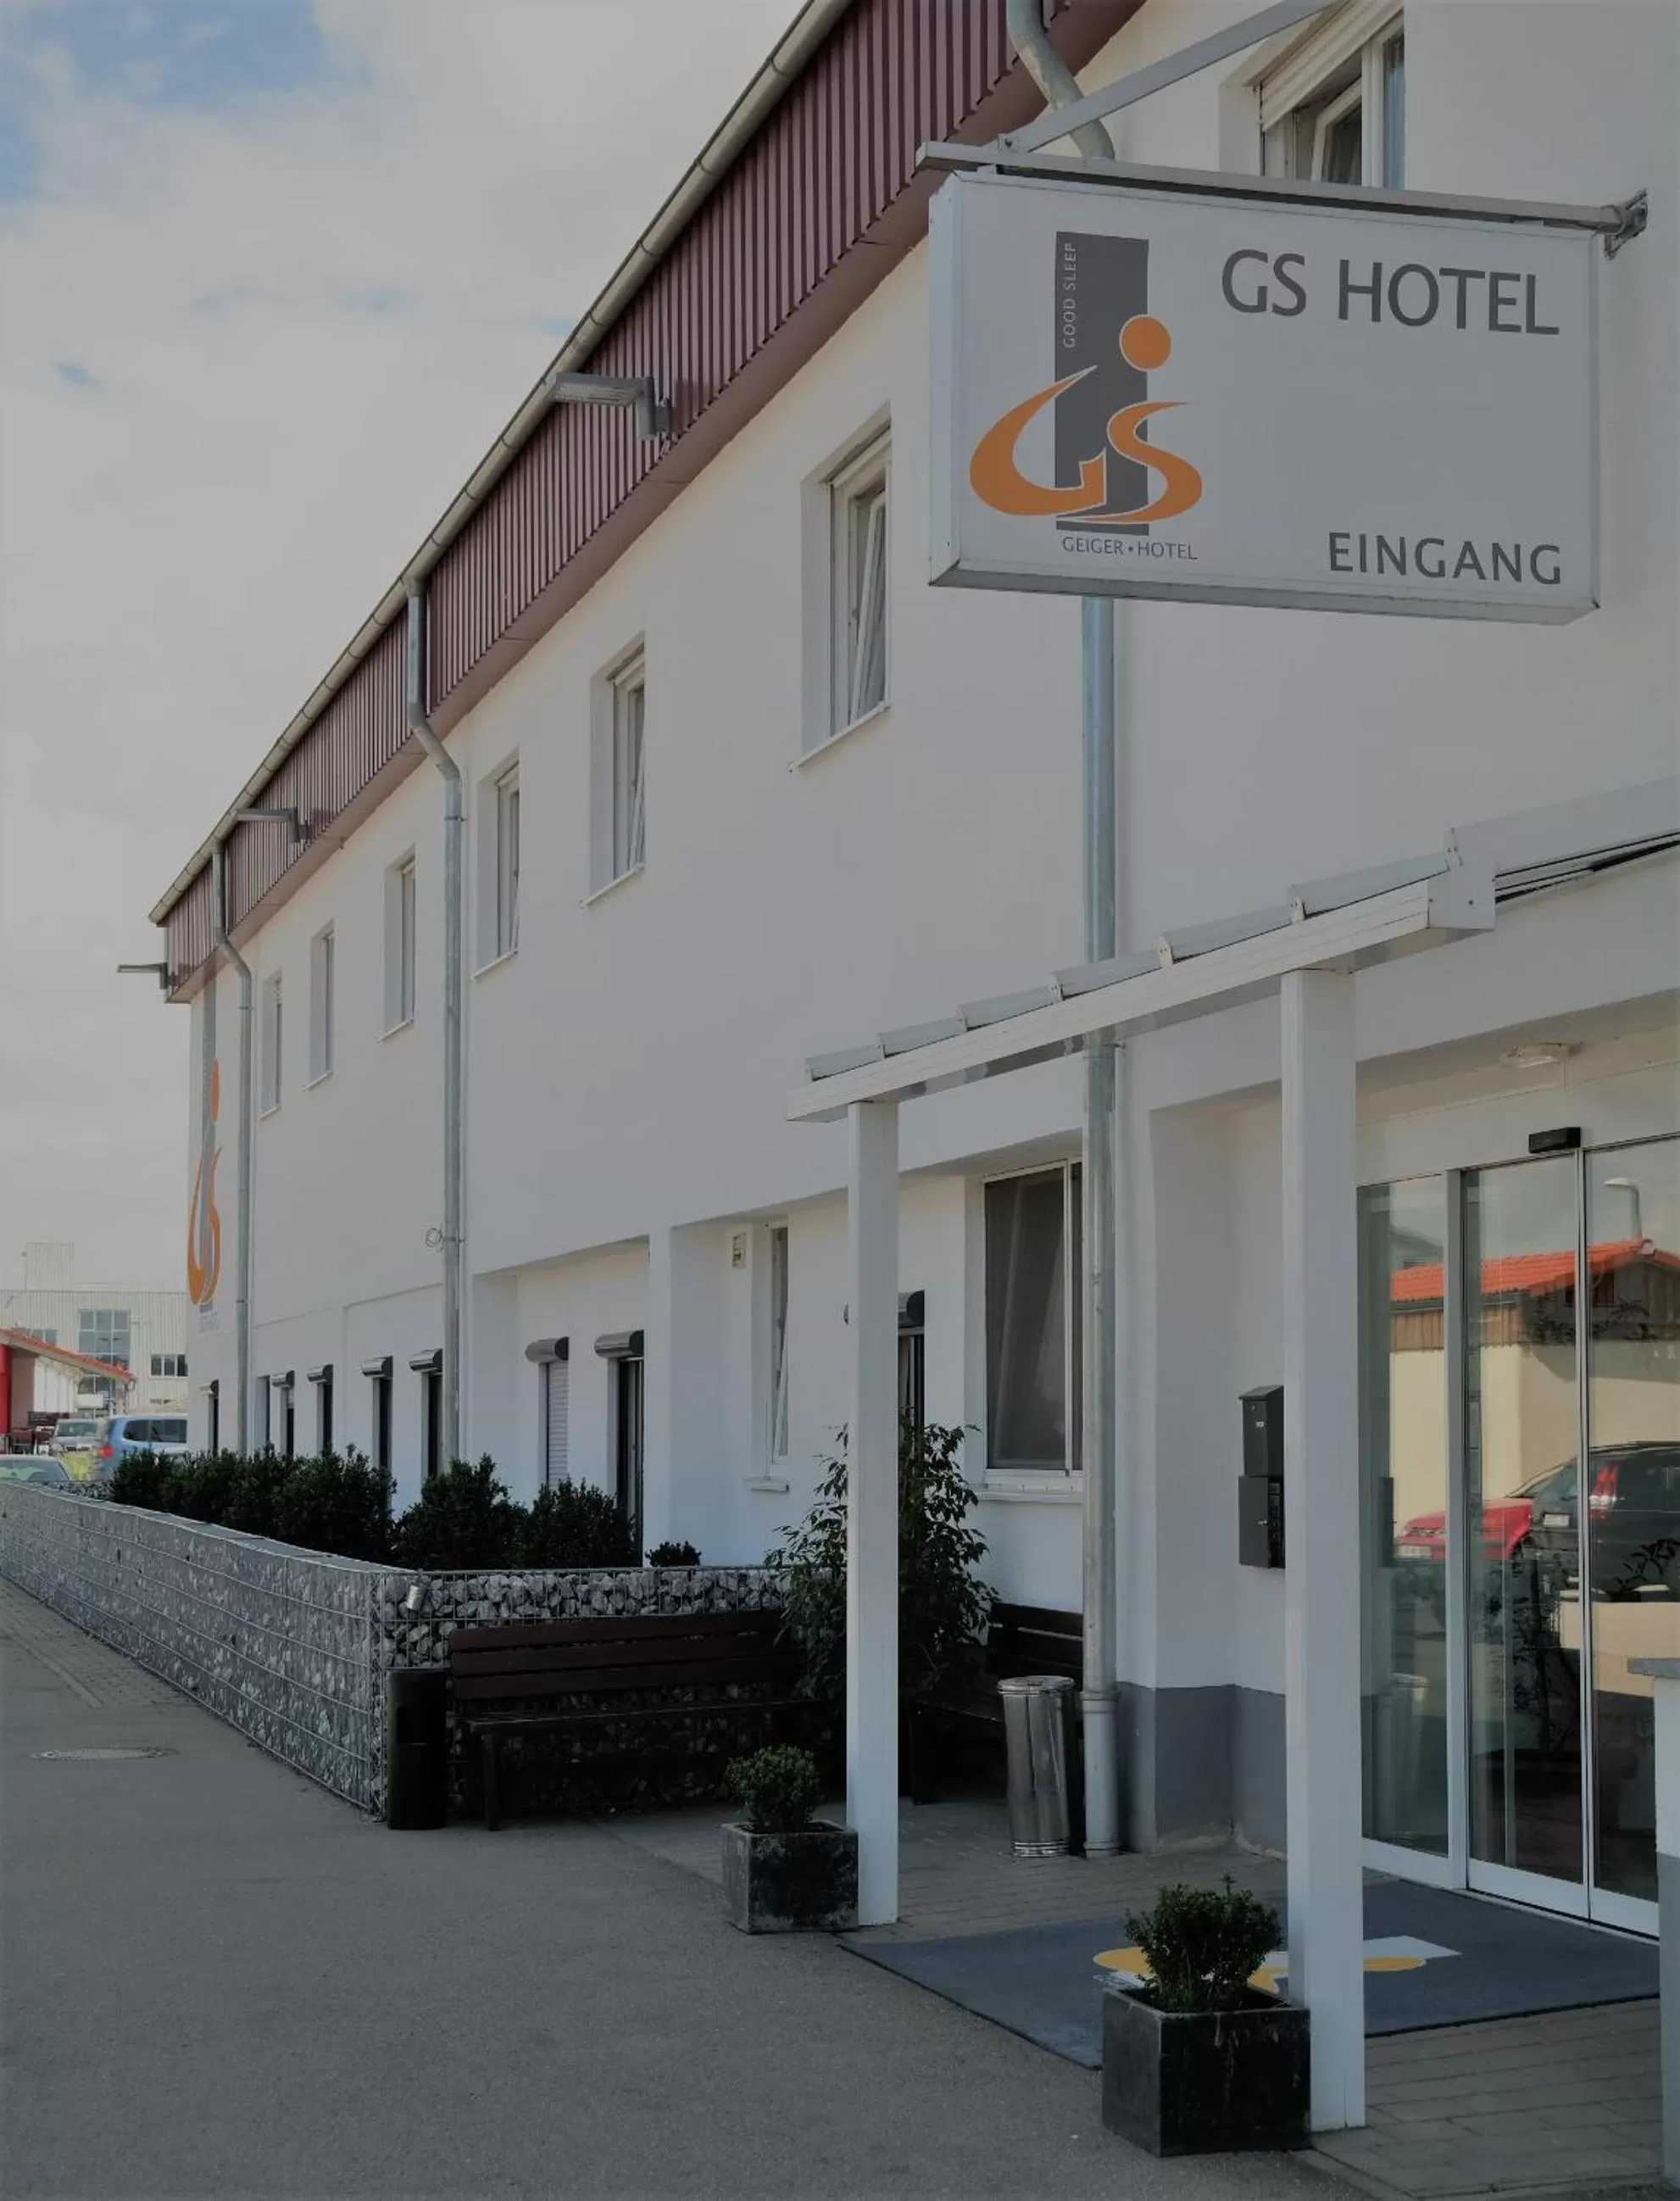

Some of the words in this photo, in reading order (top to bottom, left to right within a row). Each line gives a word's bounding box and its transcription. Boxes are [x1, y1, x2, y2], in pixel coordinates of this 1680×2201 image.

[1063, 242, 1076, 291] SLEEP
[1221, 248, 1307, 317] GS
[1338, 259, 1560, 336] HOTEL
[1063, 298, 1076, 348] GOOD
[1328, 532, 1561, 585] EINGANG
